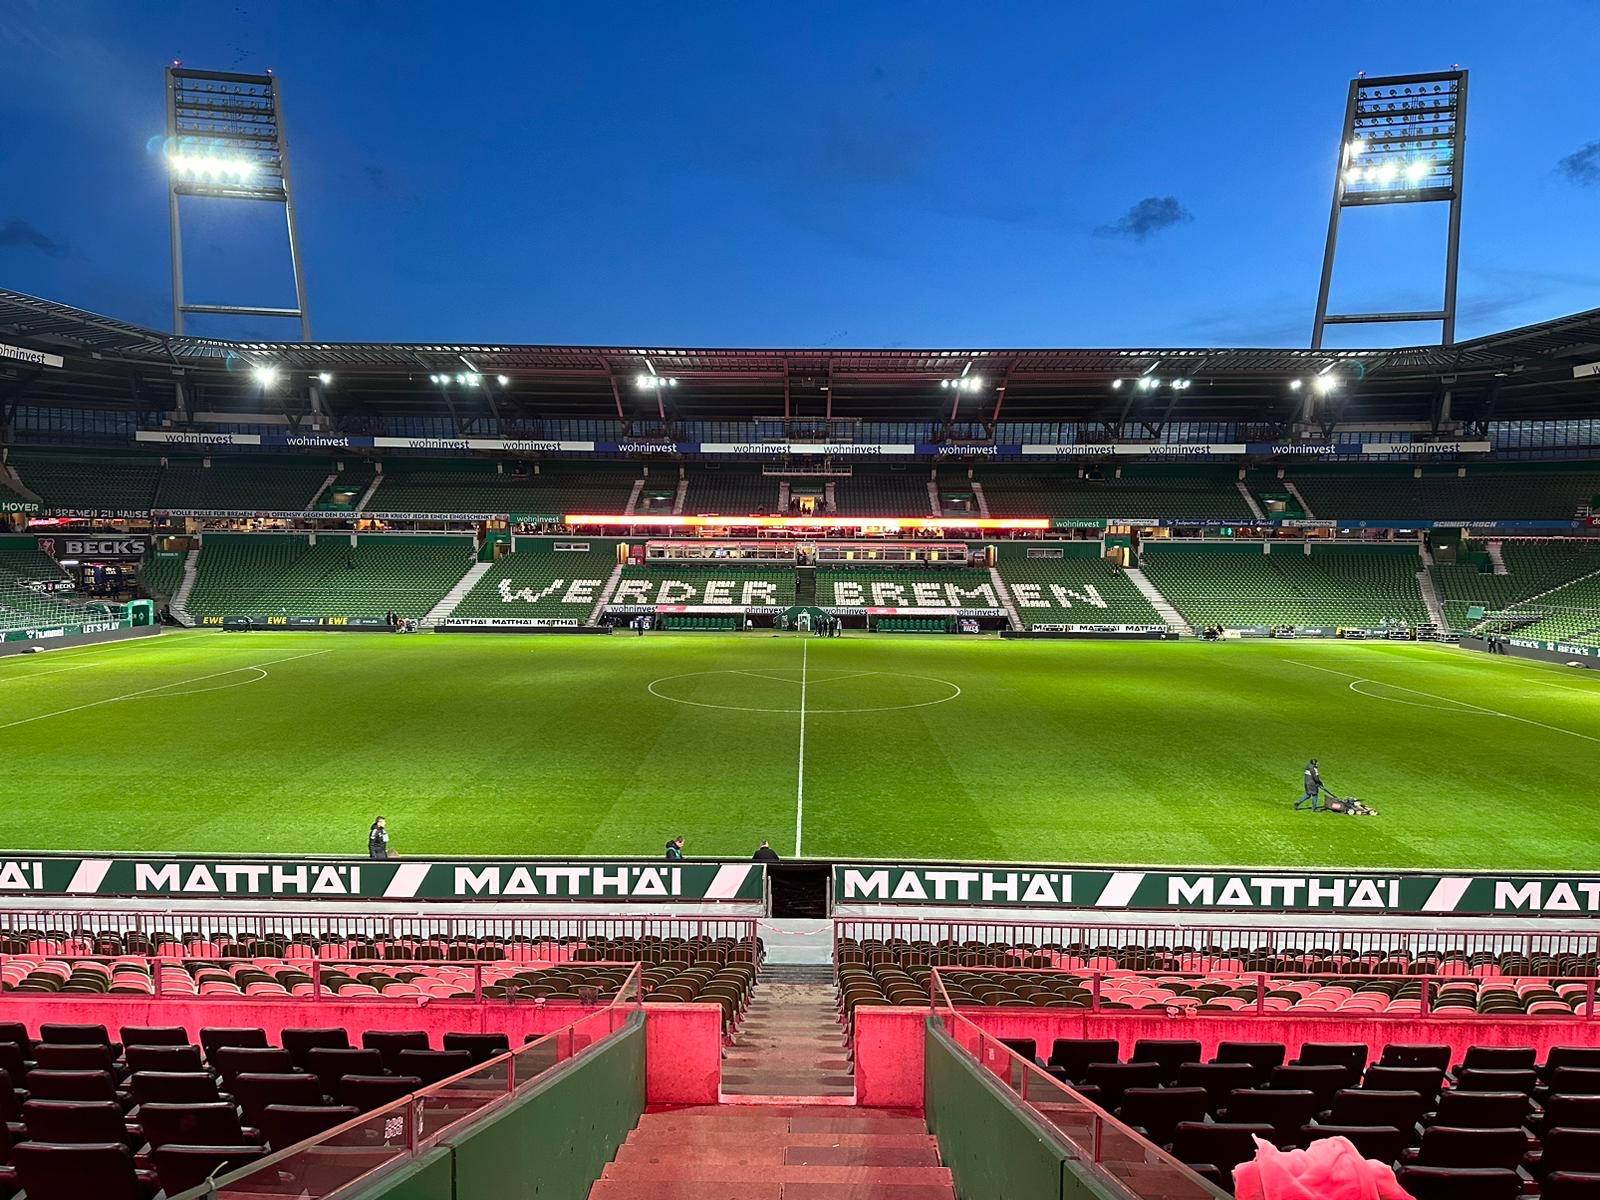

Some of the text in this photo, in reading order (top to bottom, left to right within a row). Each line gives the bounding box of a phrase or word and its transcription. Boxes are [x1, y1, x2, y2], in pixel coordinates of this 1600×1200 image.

[165, 434, 233, 443] wohninvest
[287, 437, 349, 446] wohninvest
[409, 439, 470, 449] wohninvest
[503, 441, 562, 450] wohninvest
[618, 442, 677, 453] wohninvest
[733, 443, 791, 454] wohninvest
[823, 444, 881, 454] wohninvest
[1271, 444, 1335, 454] wohninvest
[1391, 442, 1460, 453] wohninvest
[938, 445, 997, 454] wohninvest
[1055, 445, 1115, 454] wohninvest
[1149, 445, 1211, 454] wohninvest
[2, 502, 39, 512] HOYER
[117, 510, 149, 518] HAUSE
[516, 515, 560, 524] wohninvest
[1055, 519, 1100, 528] wohninvest
[66, 539, 146, 554] BECK'S
[498, 579, 1108, 608] WERDER BREMEN
[203, 616, 224, 624] EWE
[329, 617, 348, 625] EWE
[35, 627, 64, 639] hummel
[83, 622, 120, 634] LET'S PLAY
[135, 863, 361, 894] MATTHÄI
[454, 867, 681, 896] MATTHÄI
[843, 869, 1073, 903] MATTHÄI
[1167, 876, 1399, 908] MATTHÄI
